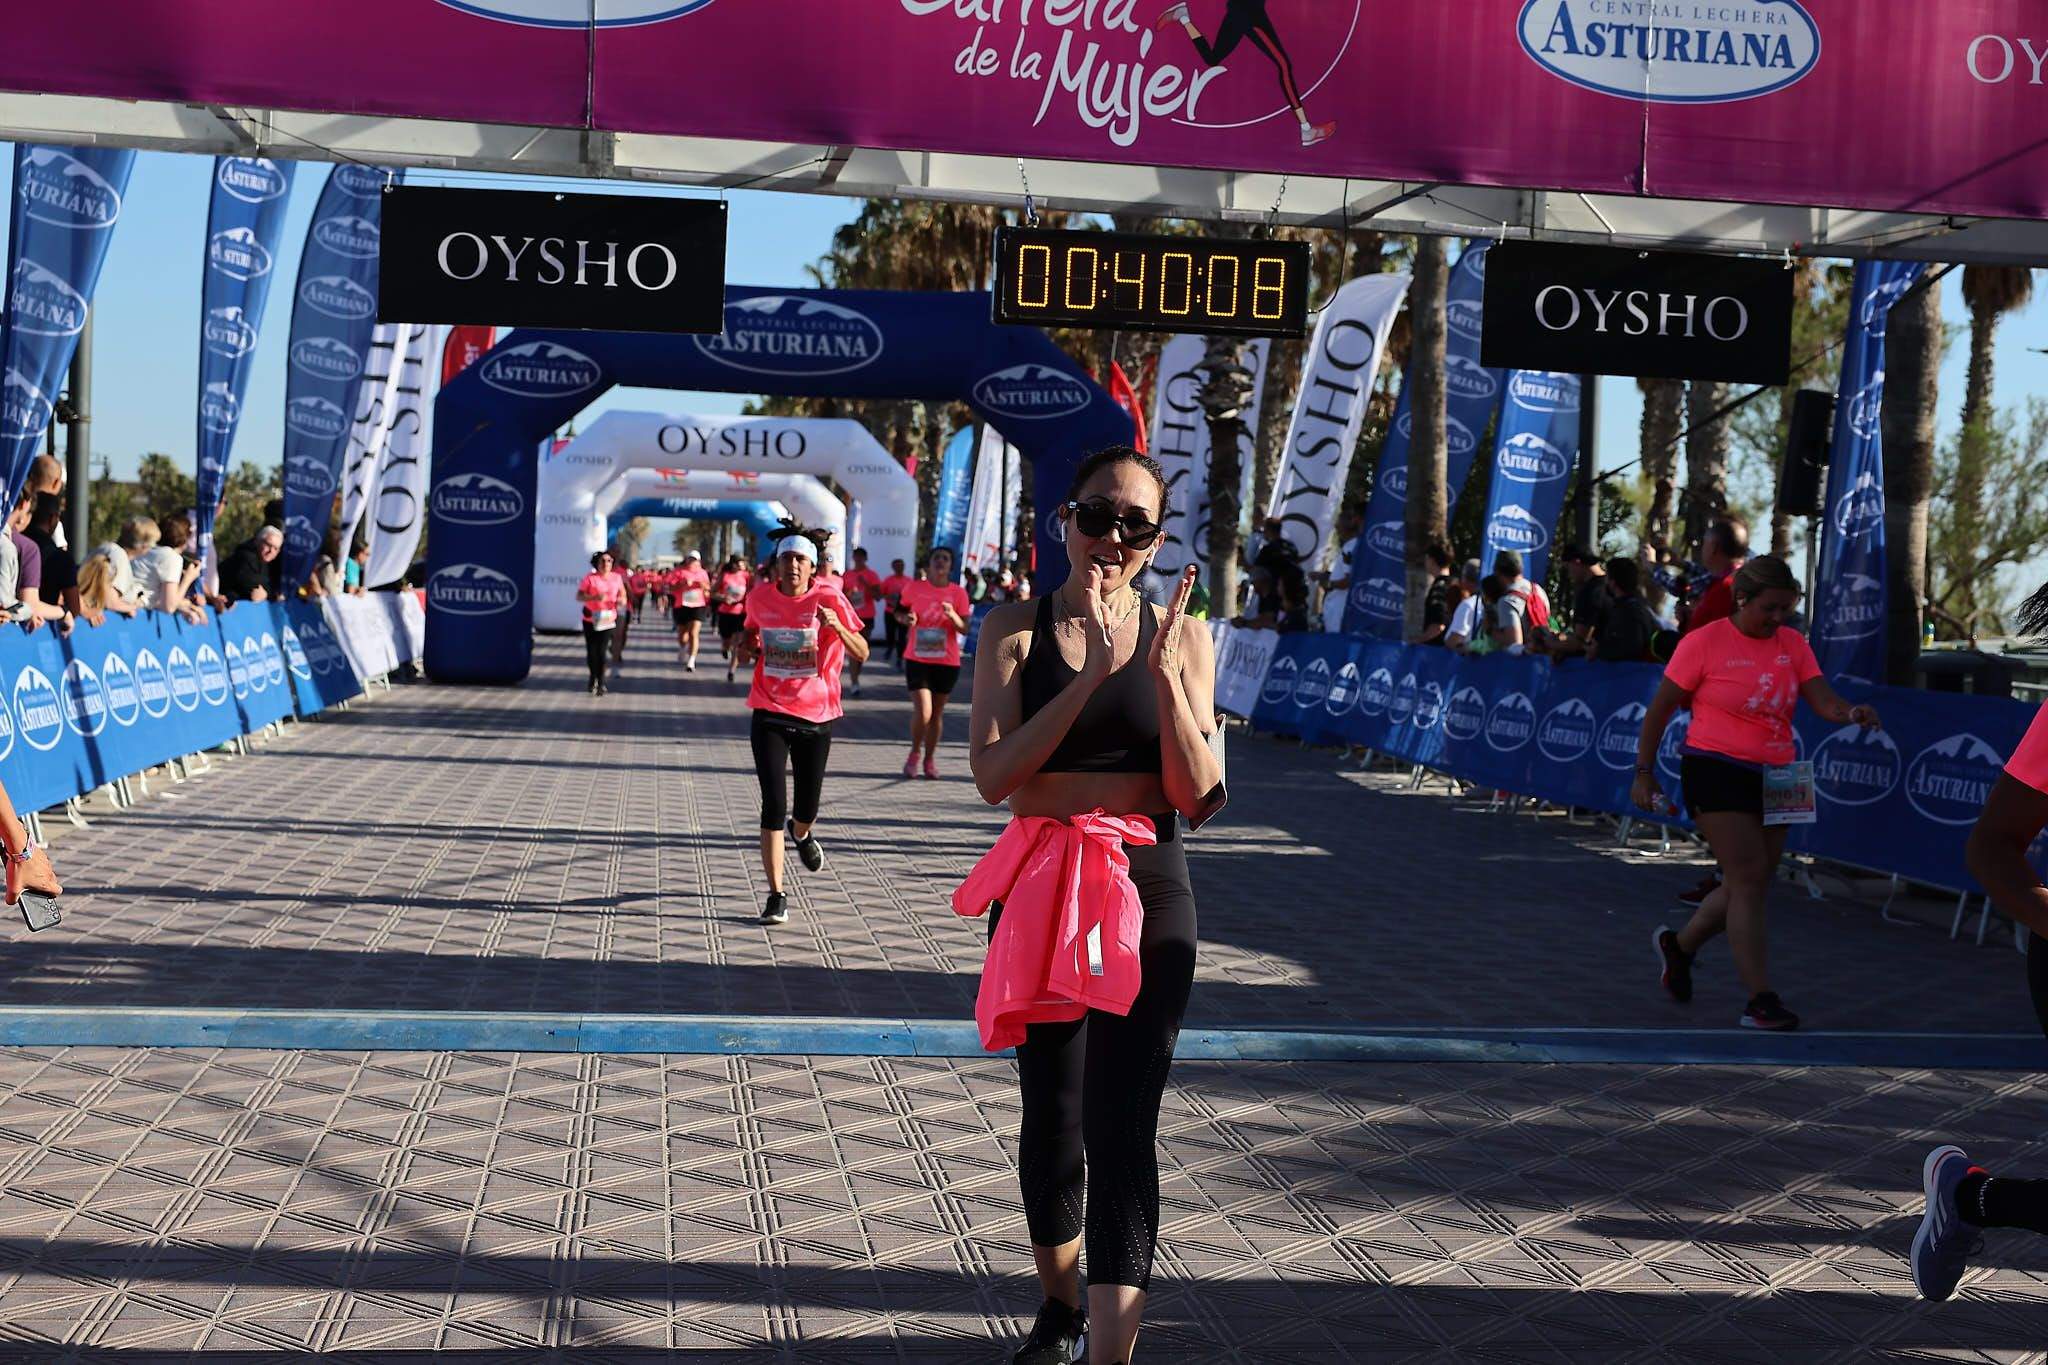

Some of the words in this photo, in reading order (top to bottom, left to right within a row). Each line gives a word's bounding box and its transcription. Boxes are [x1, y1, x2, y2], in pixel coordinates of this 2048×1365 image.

[1590, 0, 1683, 18] CENTRAL
[1693, 5, 1788, 26] LECHERA
[1541, 0, 1797, 69] ASTURIANA
[954, 25, 1000, 76] de
[1010, 27, 1042, 81] la
[1032, 28, 1227, 146] Mujer
[437, 231, 678, 291] OYSHO
[1017, 244, 1286, 320] 00:40:08
[1534, 284, 1749, 341] OYSHO
[707, 327, 868, 358] ASTURIANA
[487, 360, 591, 385] ASTURIANA
[981, 385, 1084, 405] ASTURIANA
[657, 424, 807, 460] OYSHO
[437, 490, 516, 513] ASTURIANA
[432, 581, 511, 604] ASTURIANA
[1814, 749, 1892, 788] ASTURIANA
[1911, 763, 1994, 805] ASTURIAN
